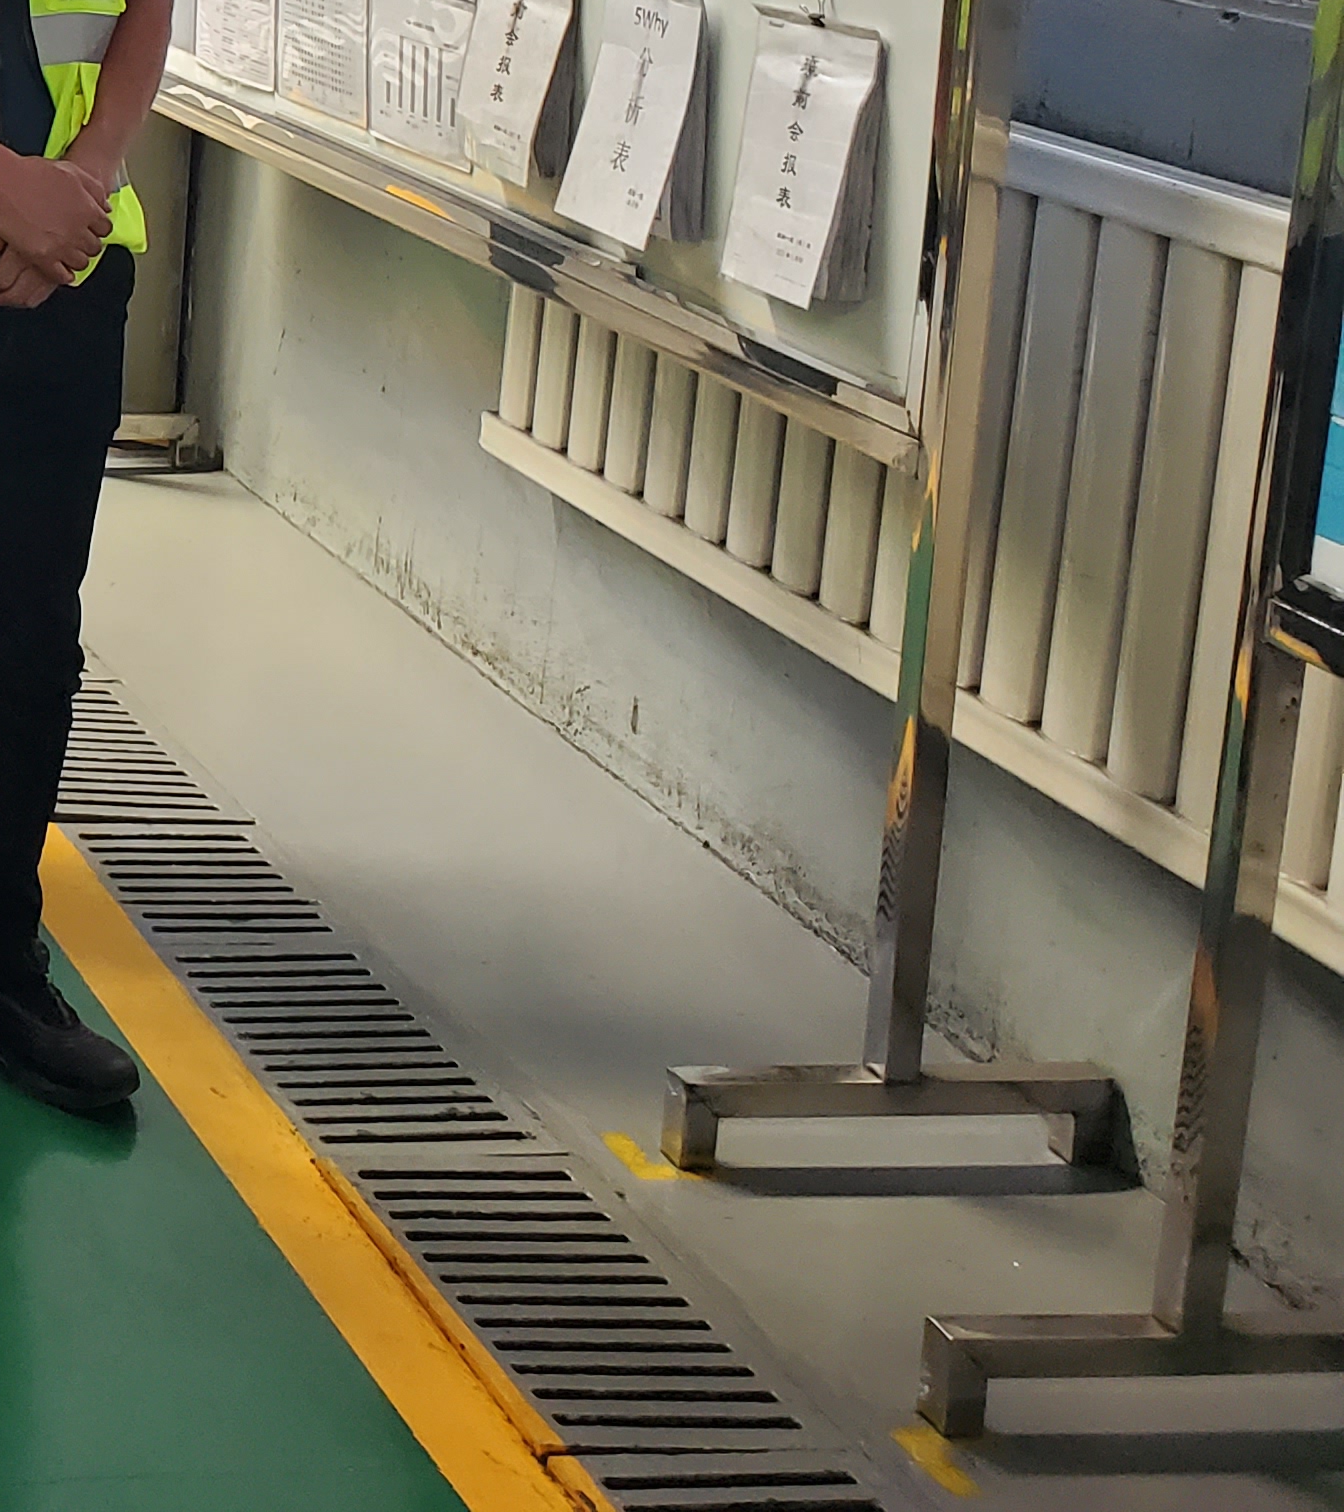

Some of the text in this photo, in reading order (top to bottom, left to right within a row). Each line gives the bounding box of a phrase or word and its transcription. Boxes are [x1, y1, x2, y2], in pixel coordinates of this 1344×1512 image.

[633, 6, 669, 39] 5Why
[610, 46, 654, 174] 分析表
